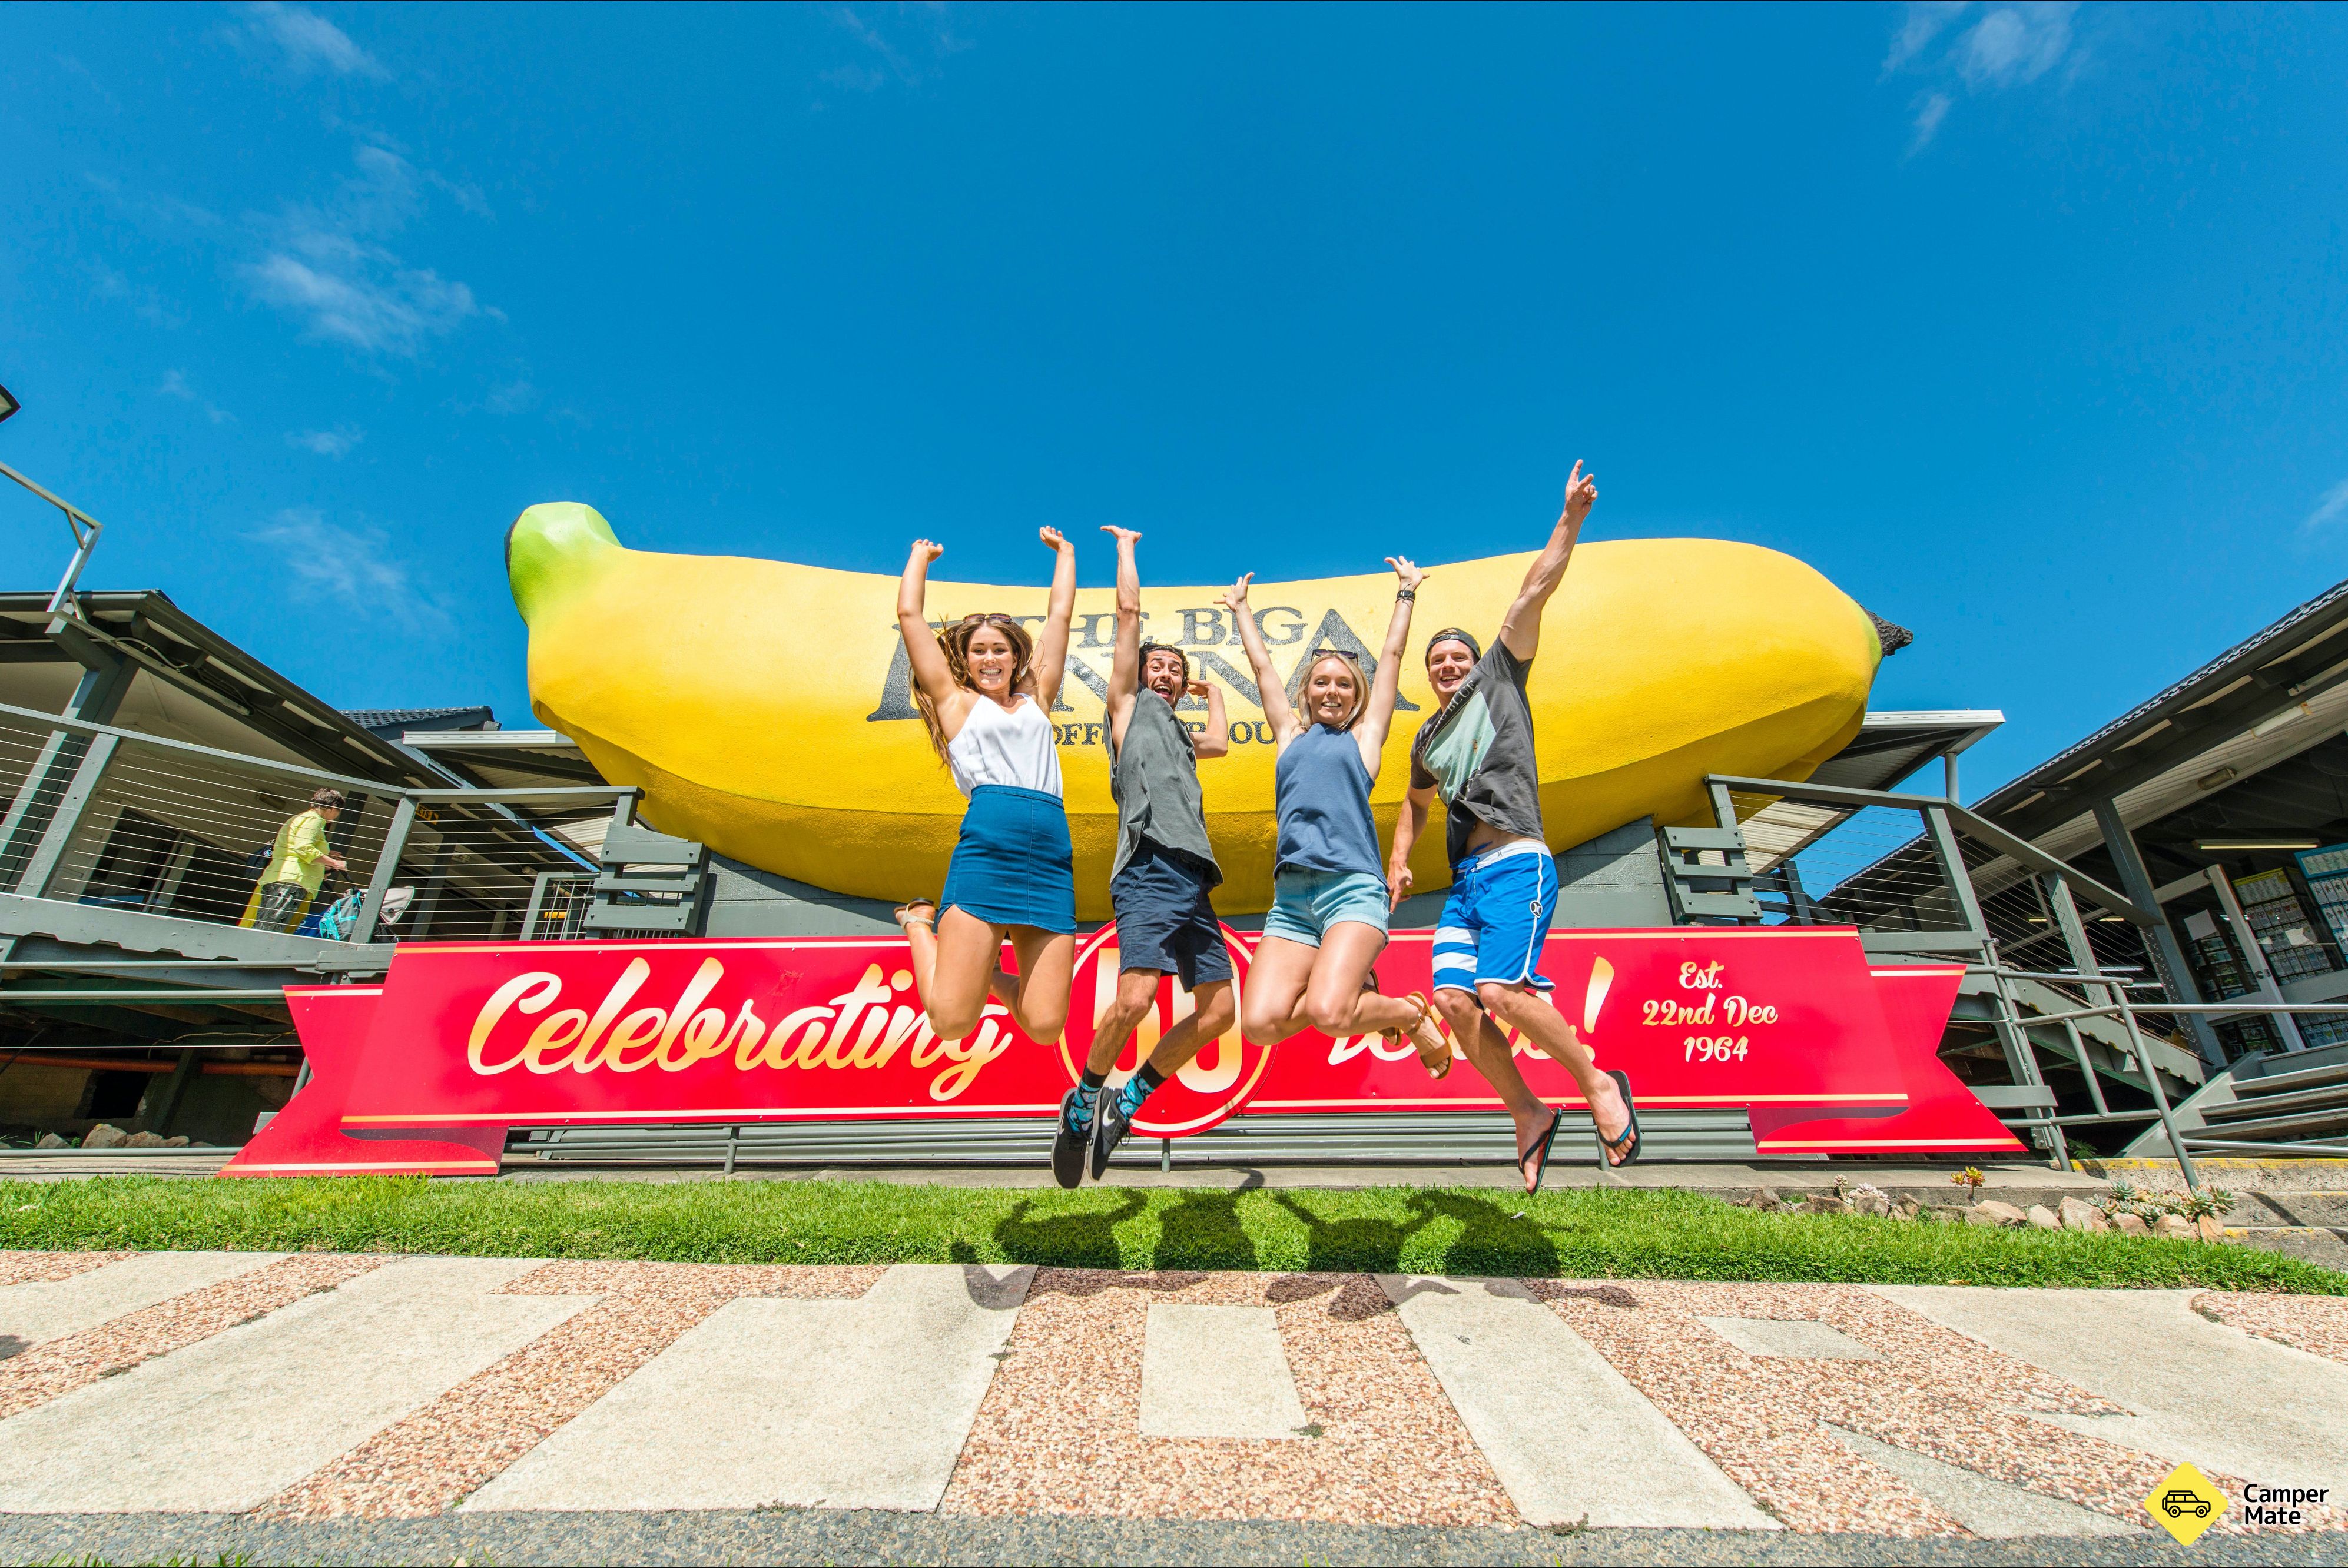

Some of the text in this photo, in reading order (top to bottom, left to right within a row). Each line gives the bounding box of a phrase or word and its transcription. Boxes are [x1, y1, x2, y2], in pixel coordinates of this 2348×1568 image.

[1175, 606, 1308, 646] BIG
[1679, 960, 1724, 989] Est.
[1642, 992, 1779, 1027] 22nd Dec
[467, 956, 1013, 1101] Celebrating
[1684, 1035, 1749, 1062] 1964
